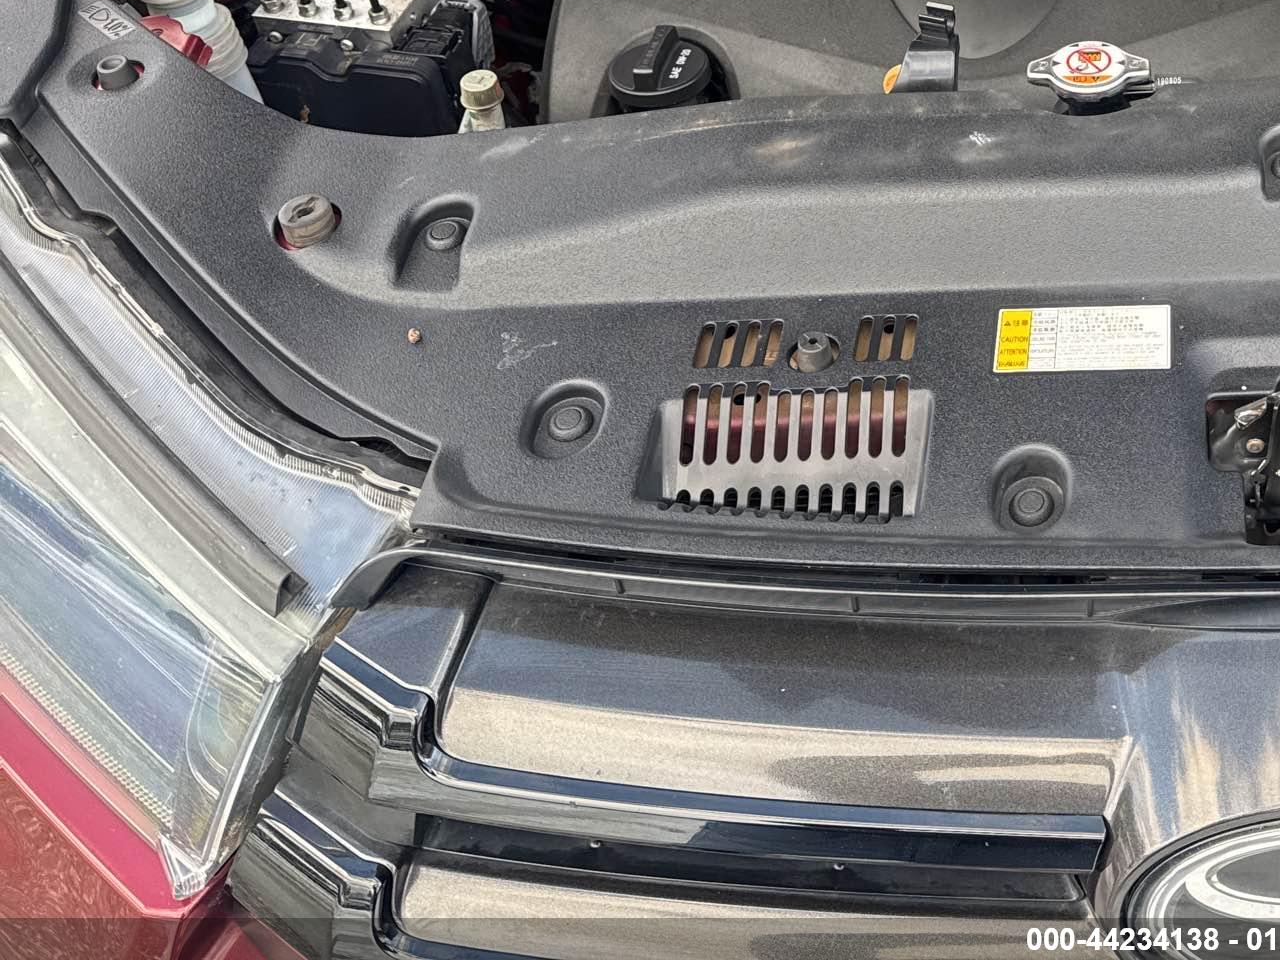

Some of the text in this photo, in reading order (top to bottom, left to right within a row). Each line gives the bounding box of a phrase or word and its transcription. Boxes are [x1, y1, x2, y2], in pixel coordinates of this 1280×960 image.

[668, 66, 682, 79] SAE
[1000, 335, 1028, 343] CAUTION
[999, 348, 1028, 356] ATTENTION
